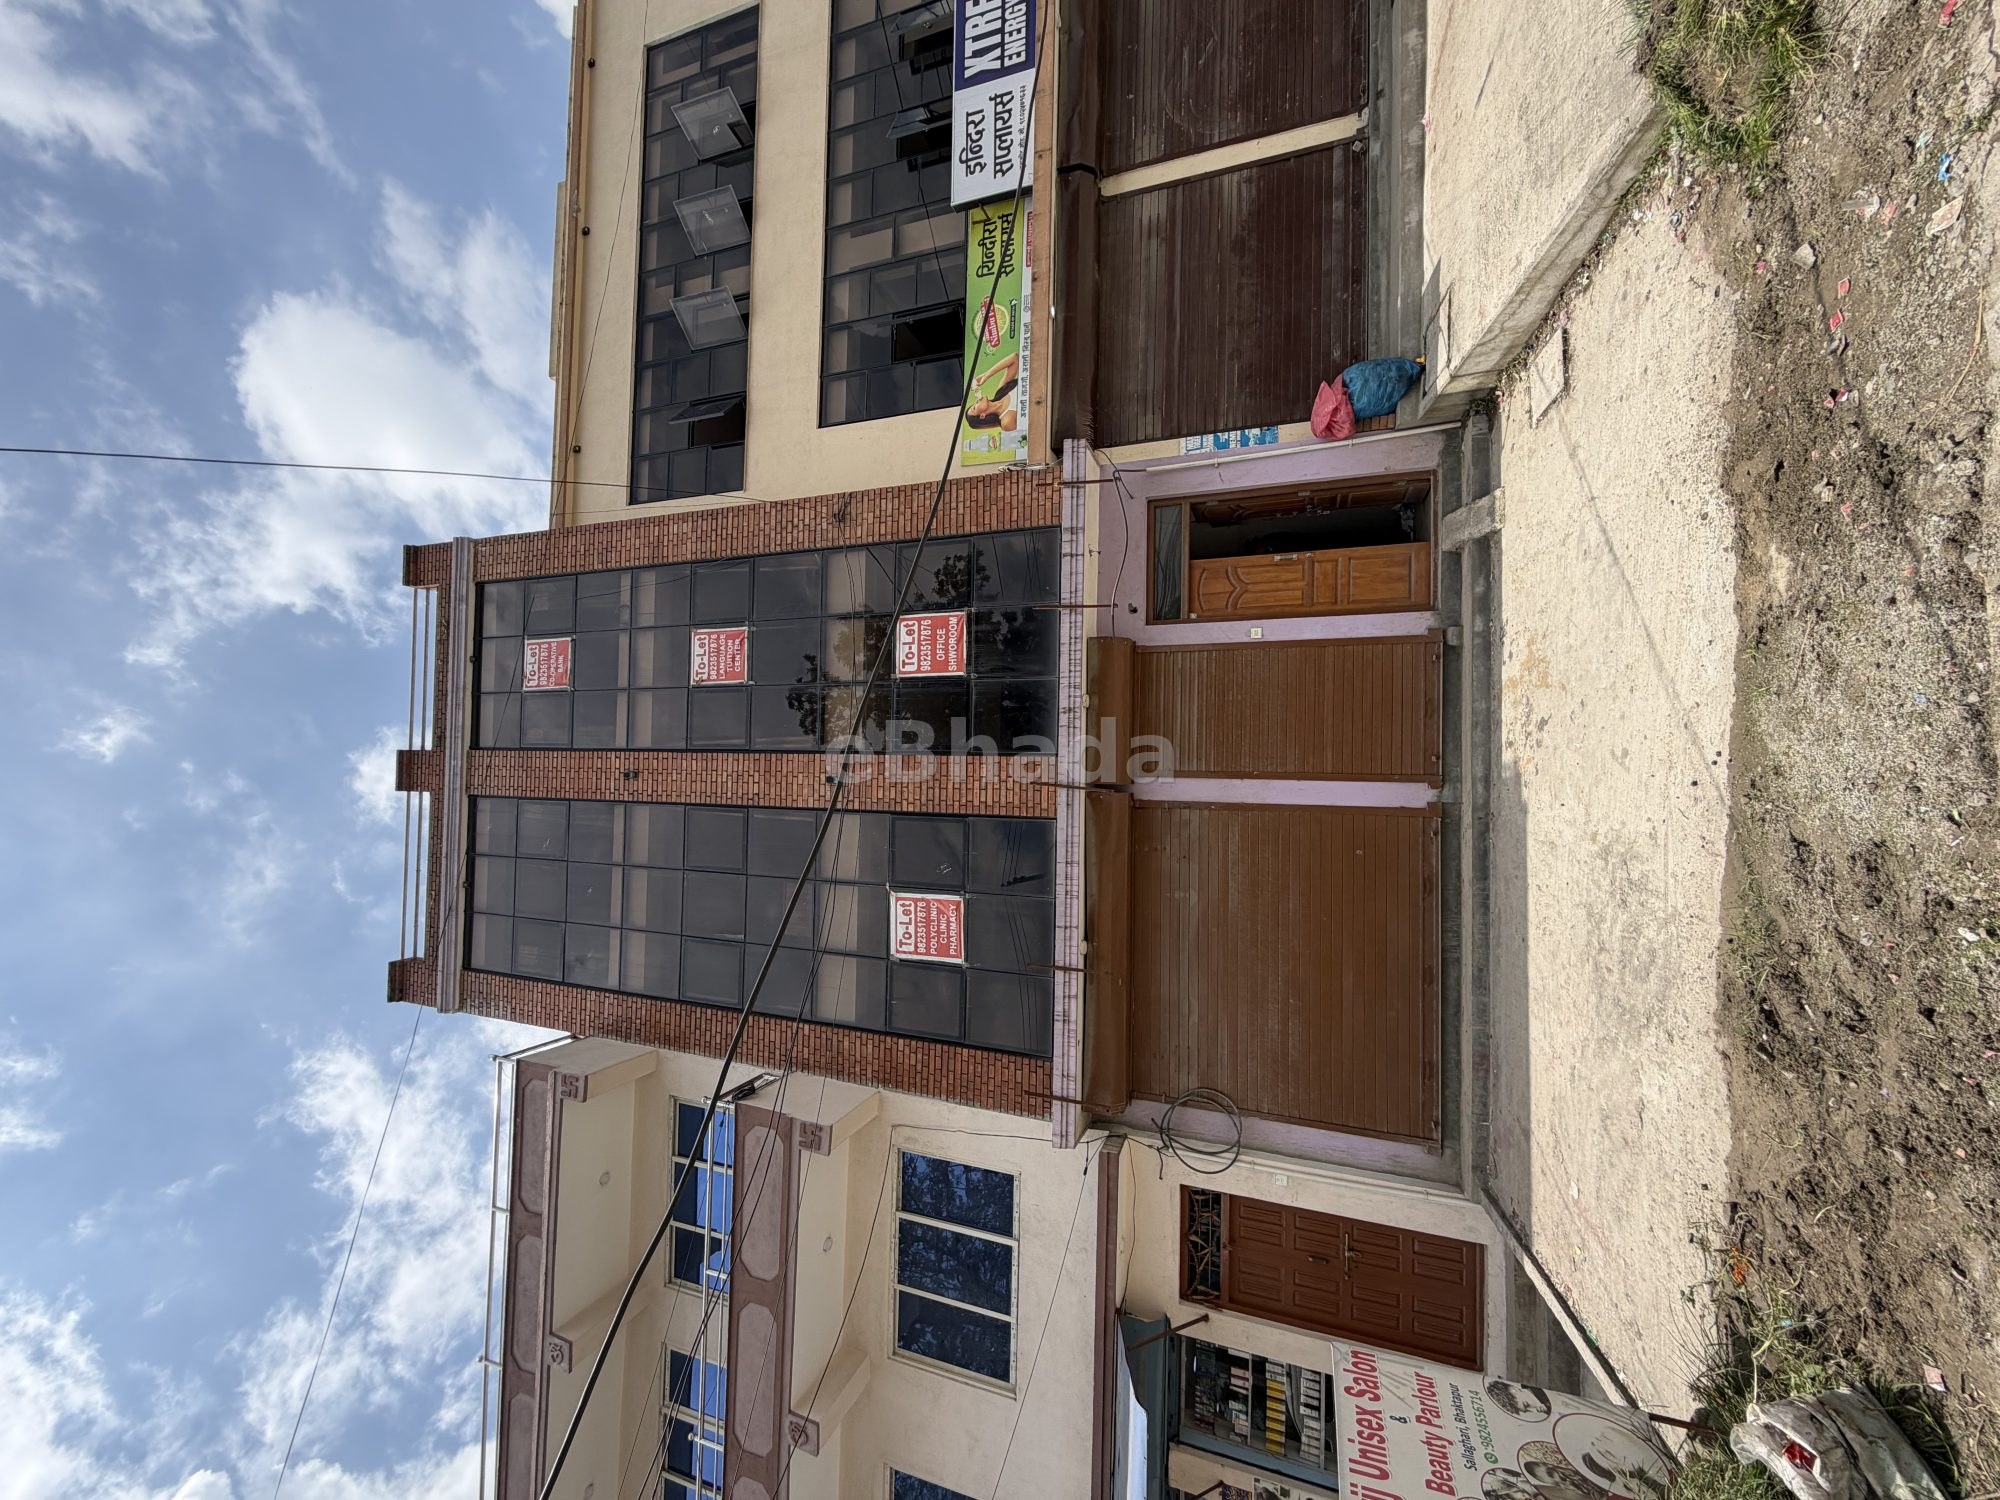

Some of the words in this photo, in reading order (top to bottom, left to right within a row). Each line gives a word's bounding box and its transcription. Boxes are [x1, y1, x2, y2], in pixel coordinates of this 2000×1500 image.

[958, 108, 987, 177] इन्दिरा
[989, 90, 1014, 179] सप्लायर्स
[526, 646, 537, 684] To-Let
[540, 644, 548, 686] 9823517876
[696, 636, 706, 678] To-Let
[710, 634, 718, 680] 9823517876
[902, 622, 916, 669] To-Let
[920, 620, 931, 671] 9823517876
[936, 628, 945, 660] OFFICE
[948, 616, 957, 671] SHWOROOM
[899, 902, 912, 948] To-Let
[917, 902, 926, 953] 9823517876
[930, 902, 938, 954] POLYCLINIC
[949, 903, 957, 955] PHARMACY
[1342, 1350, 1381, 1402] Salon
[1412, 1372, 1443, 1429] Parlour
[1390, 1415, 1407, 1424] &
[1449, 1383, 1466, 1424] Bhaktapur
[1348, 1404, 1390, 1480] Unisex
[1419, 1430, 1456, 1496] Beauty
[1456, 1426, 1477, 1471] Sallaghari,
